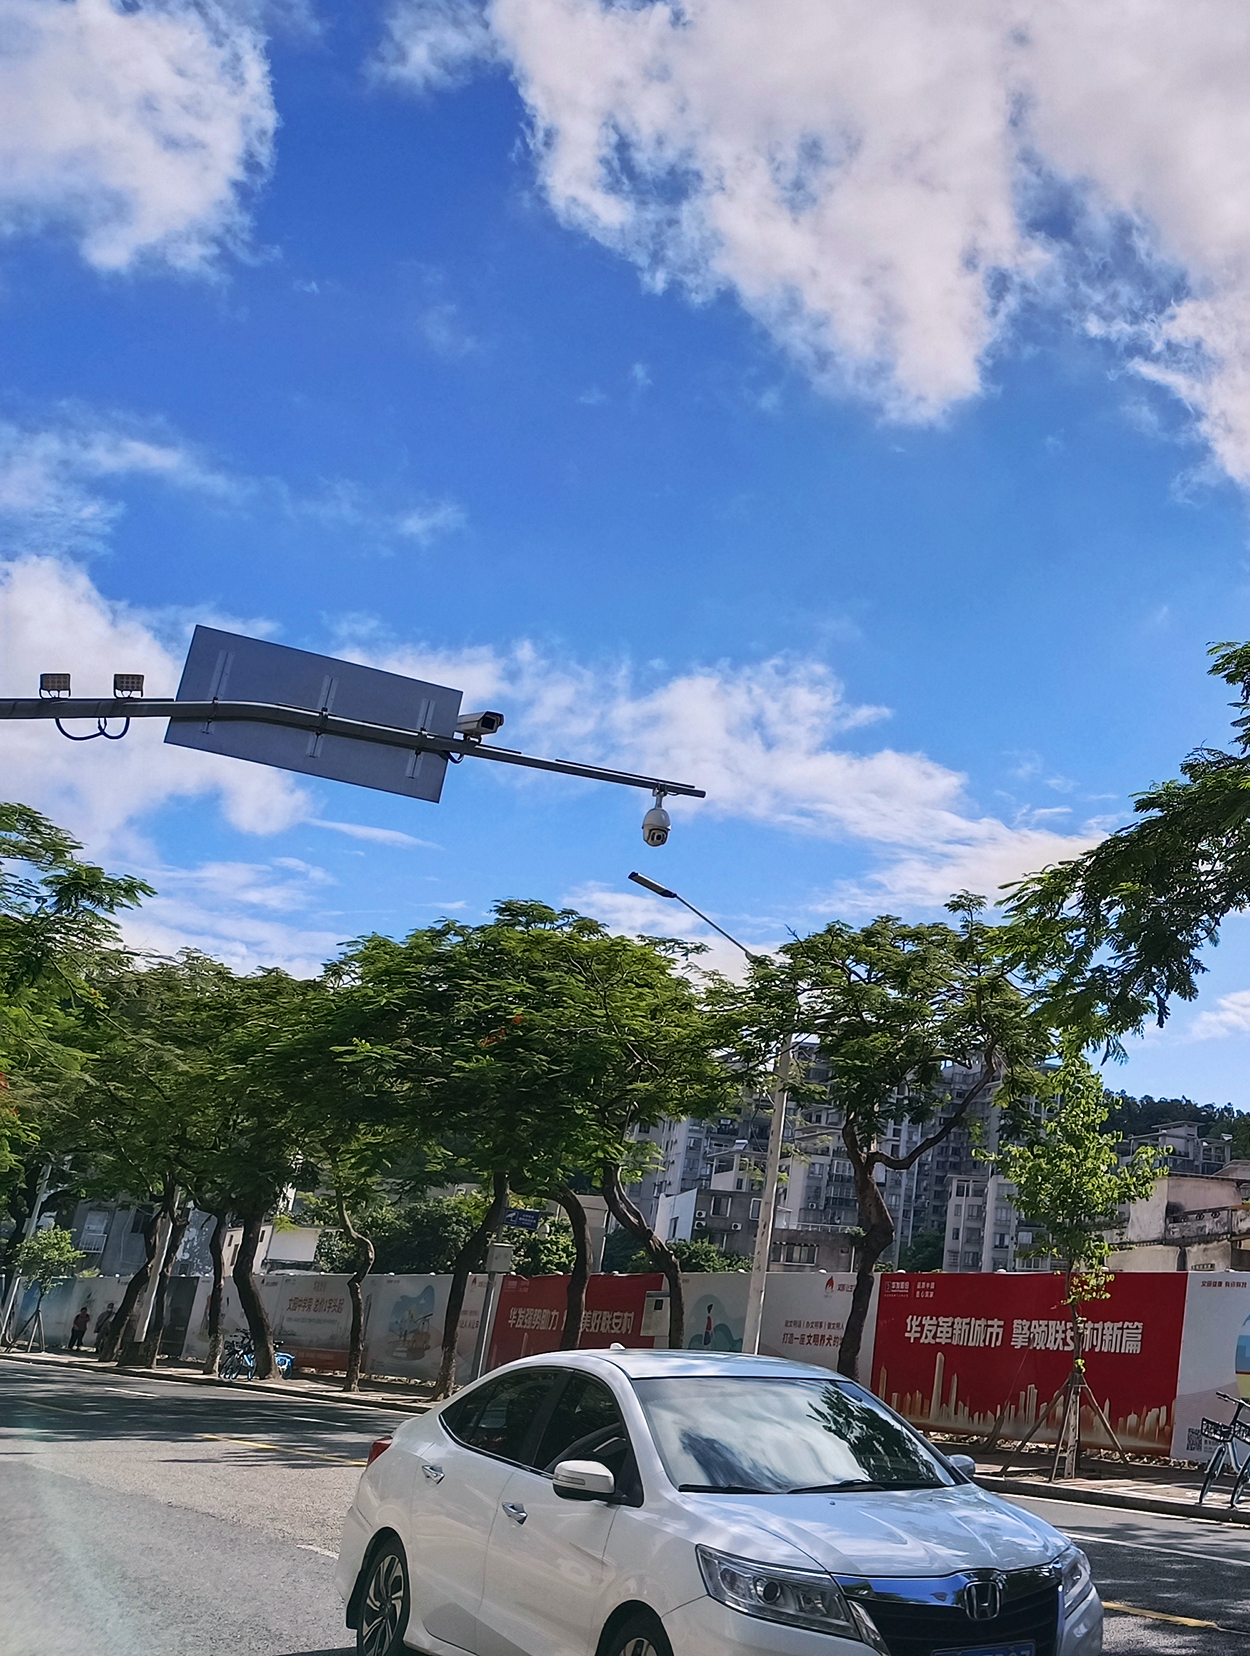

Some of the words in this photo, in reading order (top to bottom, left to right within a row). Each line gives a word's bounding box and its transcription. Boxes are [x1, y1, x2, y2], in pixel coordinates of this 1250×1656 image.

[561, 1309, 635, 1334] 美好联安村
[904, 1314, 1005, 1349] 华发革新城市
[781, 1332, 844, 1348] 打造一座文明养犬的
